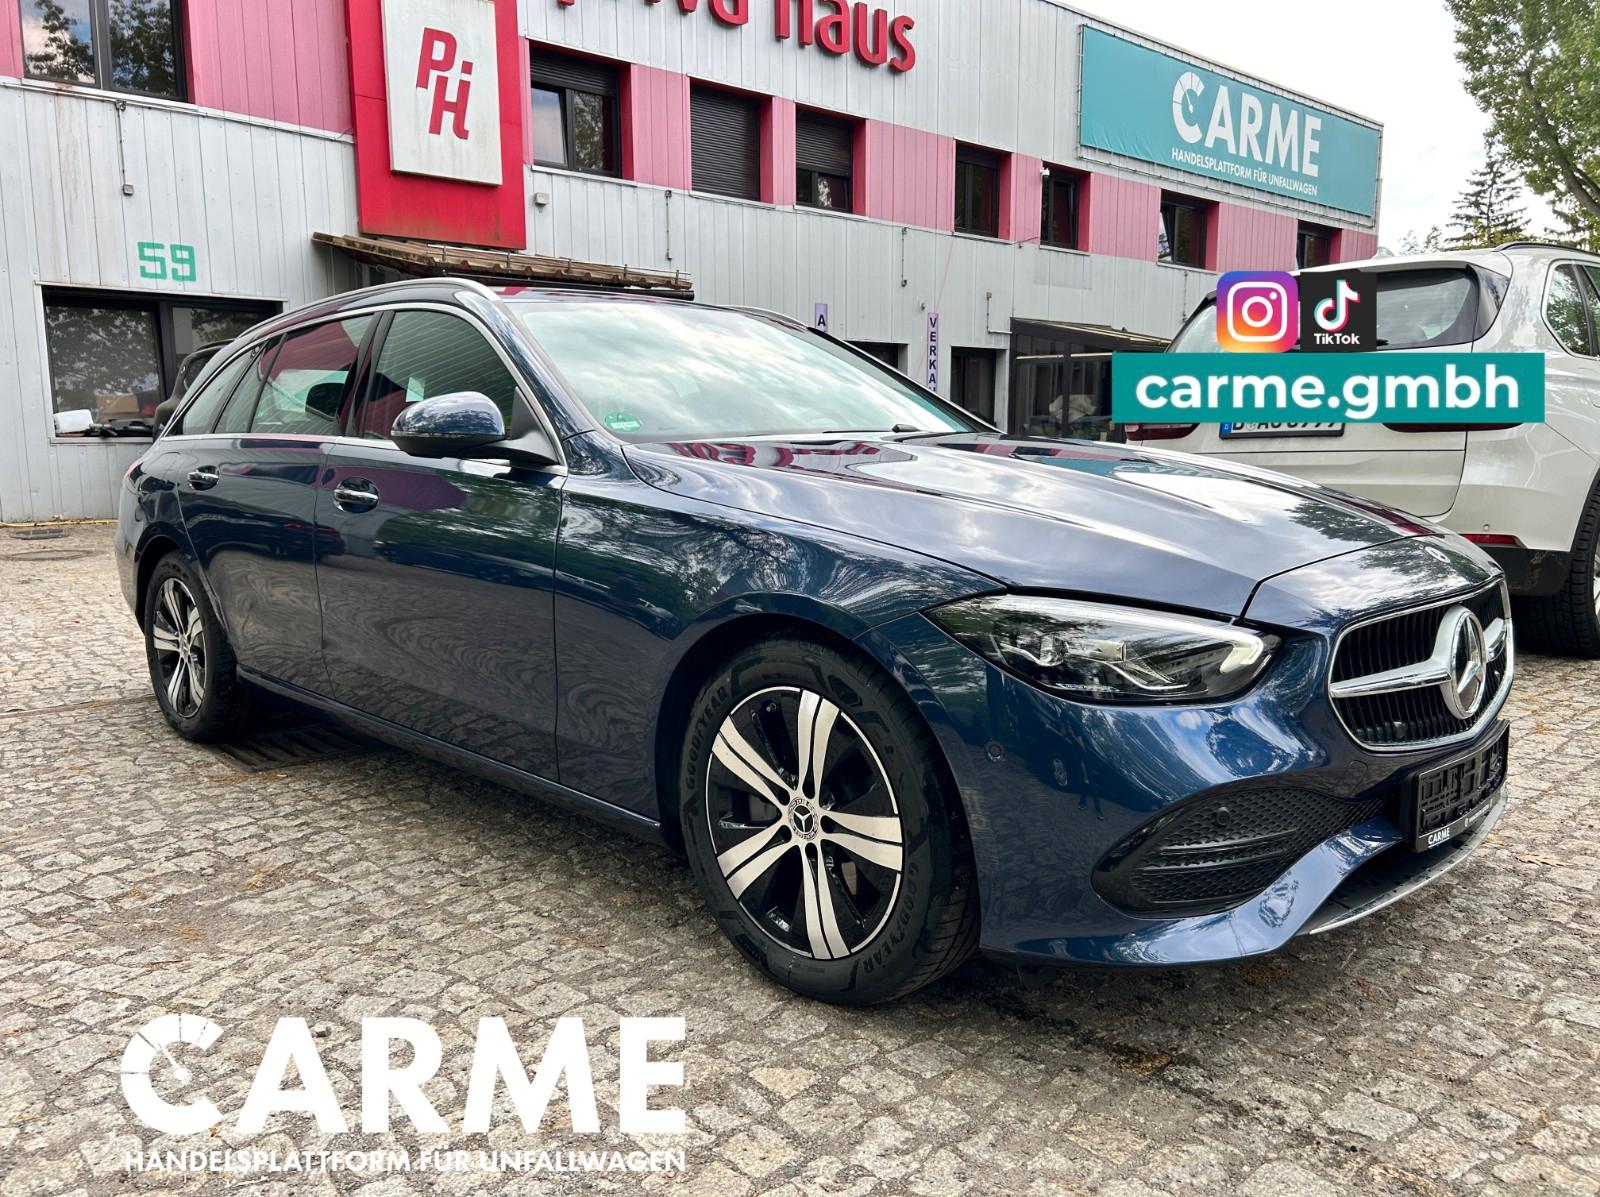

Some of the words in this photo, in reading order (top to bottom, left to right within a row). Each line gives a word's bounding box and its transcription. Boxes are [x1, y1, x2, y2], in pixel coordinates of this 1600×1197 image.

[1172, 71, 1322, 177] CARME
[1171, 147, 1252, 180] HANDELSPLATTFORM
[1253, 167, 1268, 184] FÜR
[1268, 174, 1318, 197] UNFALLWAGEN
[137, 242, 197, 282] 59
[1428, 827, 1450, 845] CARME
